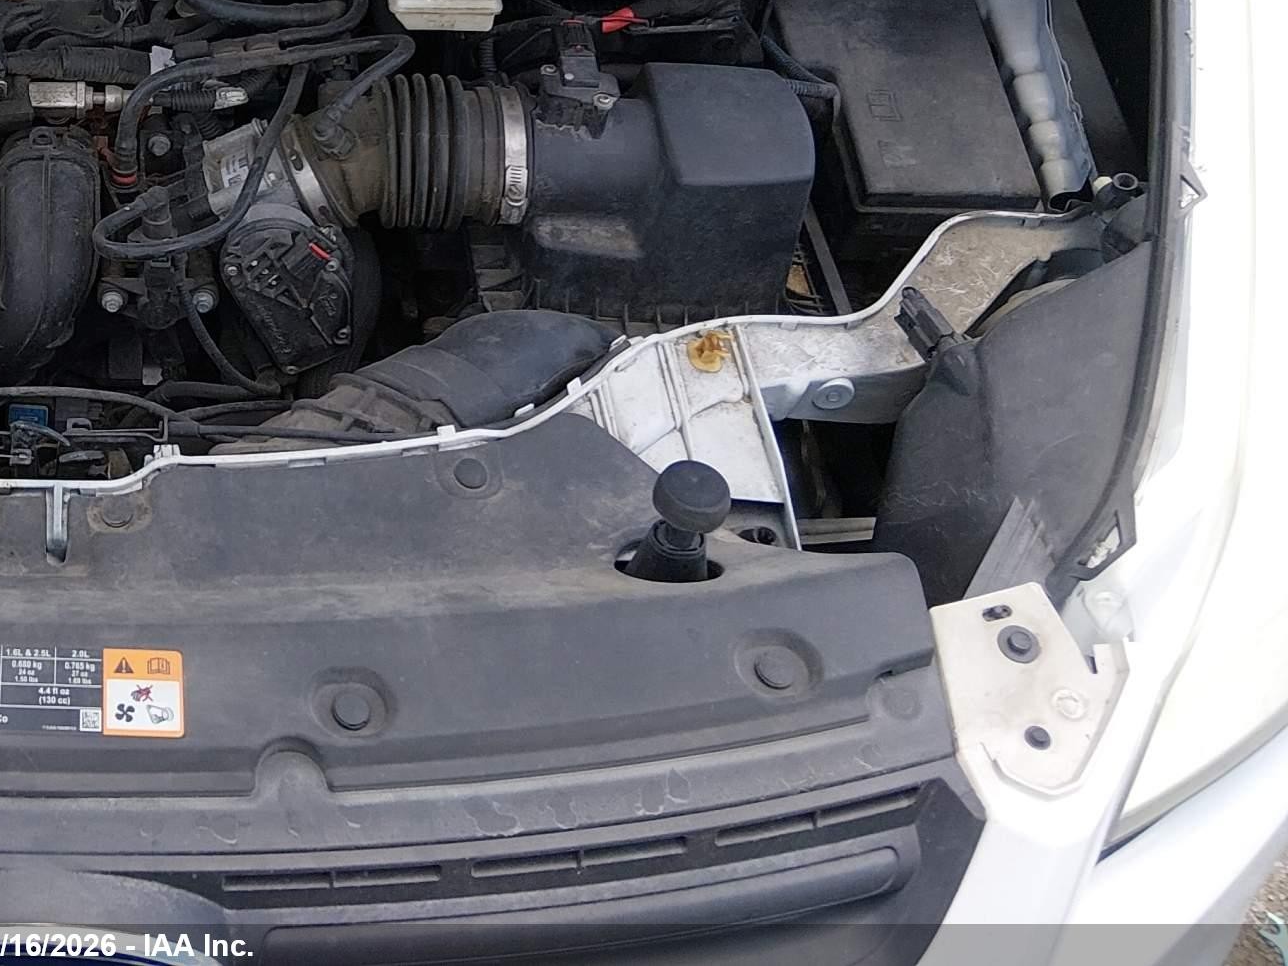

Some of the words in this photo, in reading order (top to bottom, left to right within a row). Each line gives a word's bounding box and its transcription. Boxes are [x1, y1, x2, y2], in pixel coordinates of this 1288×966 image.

[25, 648, 32, 657] &
[33, 649, 52, 658] 2.5L
[71, 649, 90, 658] 2.0L
[32, 660, 43, 670] kg
[85, 662, 96, 672] kg
[37, 687, 51, 695] 4.4
[52, 687, 59, 695] fl
[38, 696, 56, 705] (130
[57, 696, 71, 705] cc)
